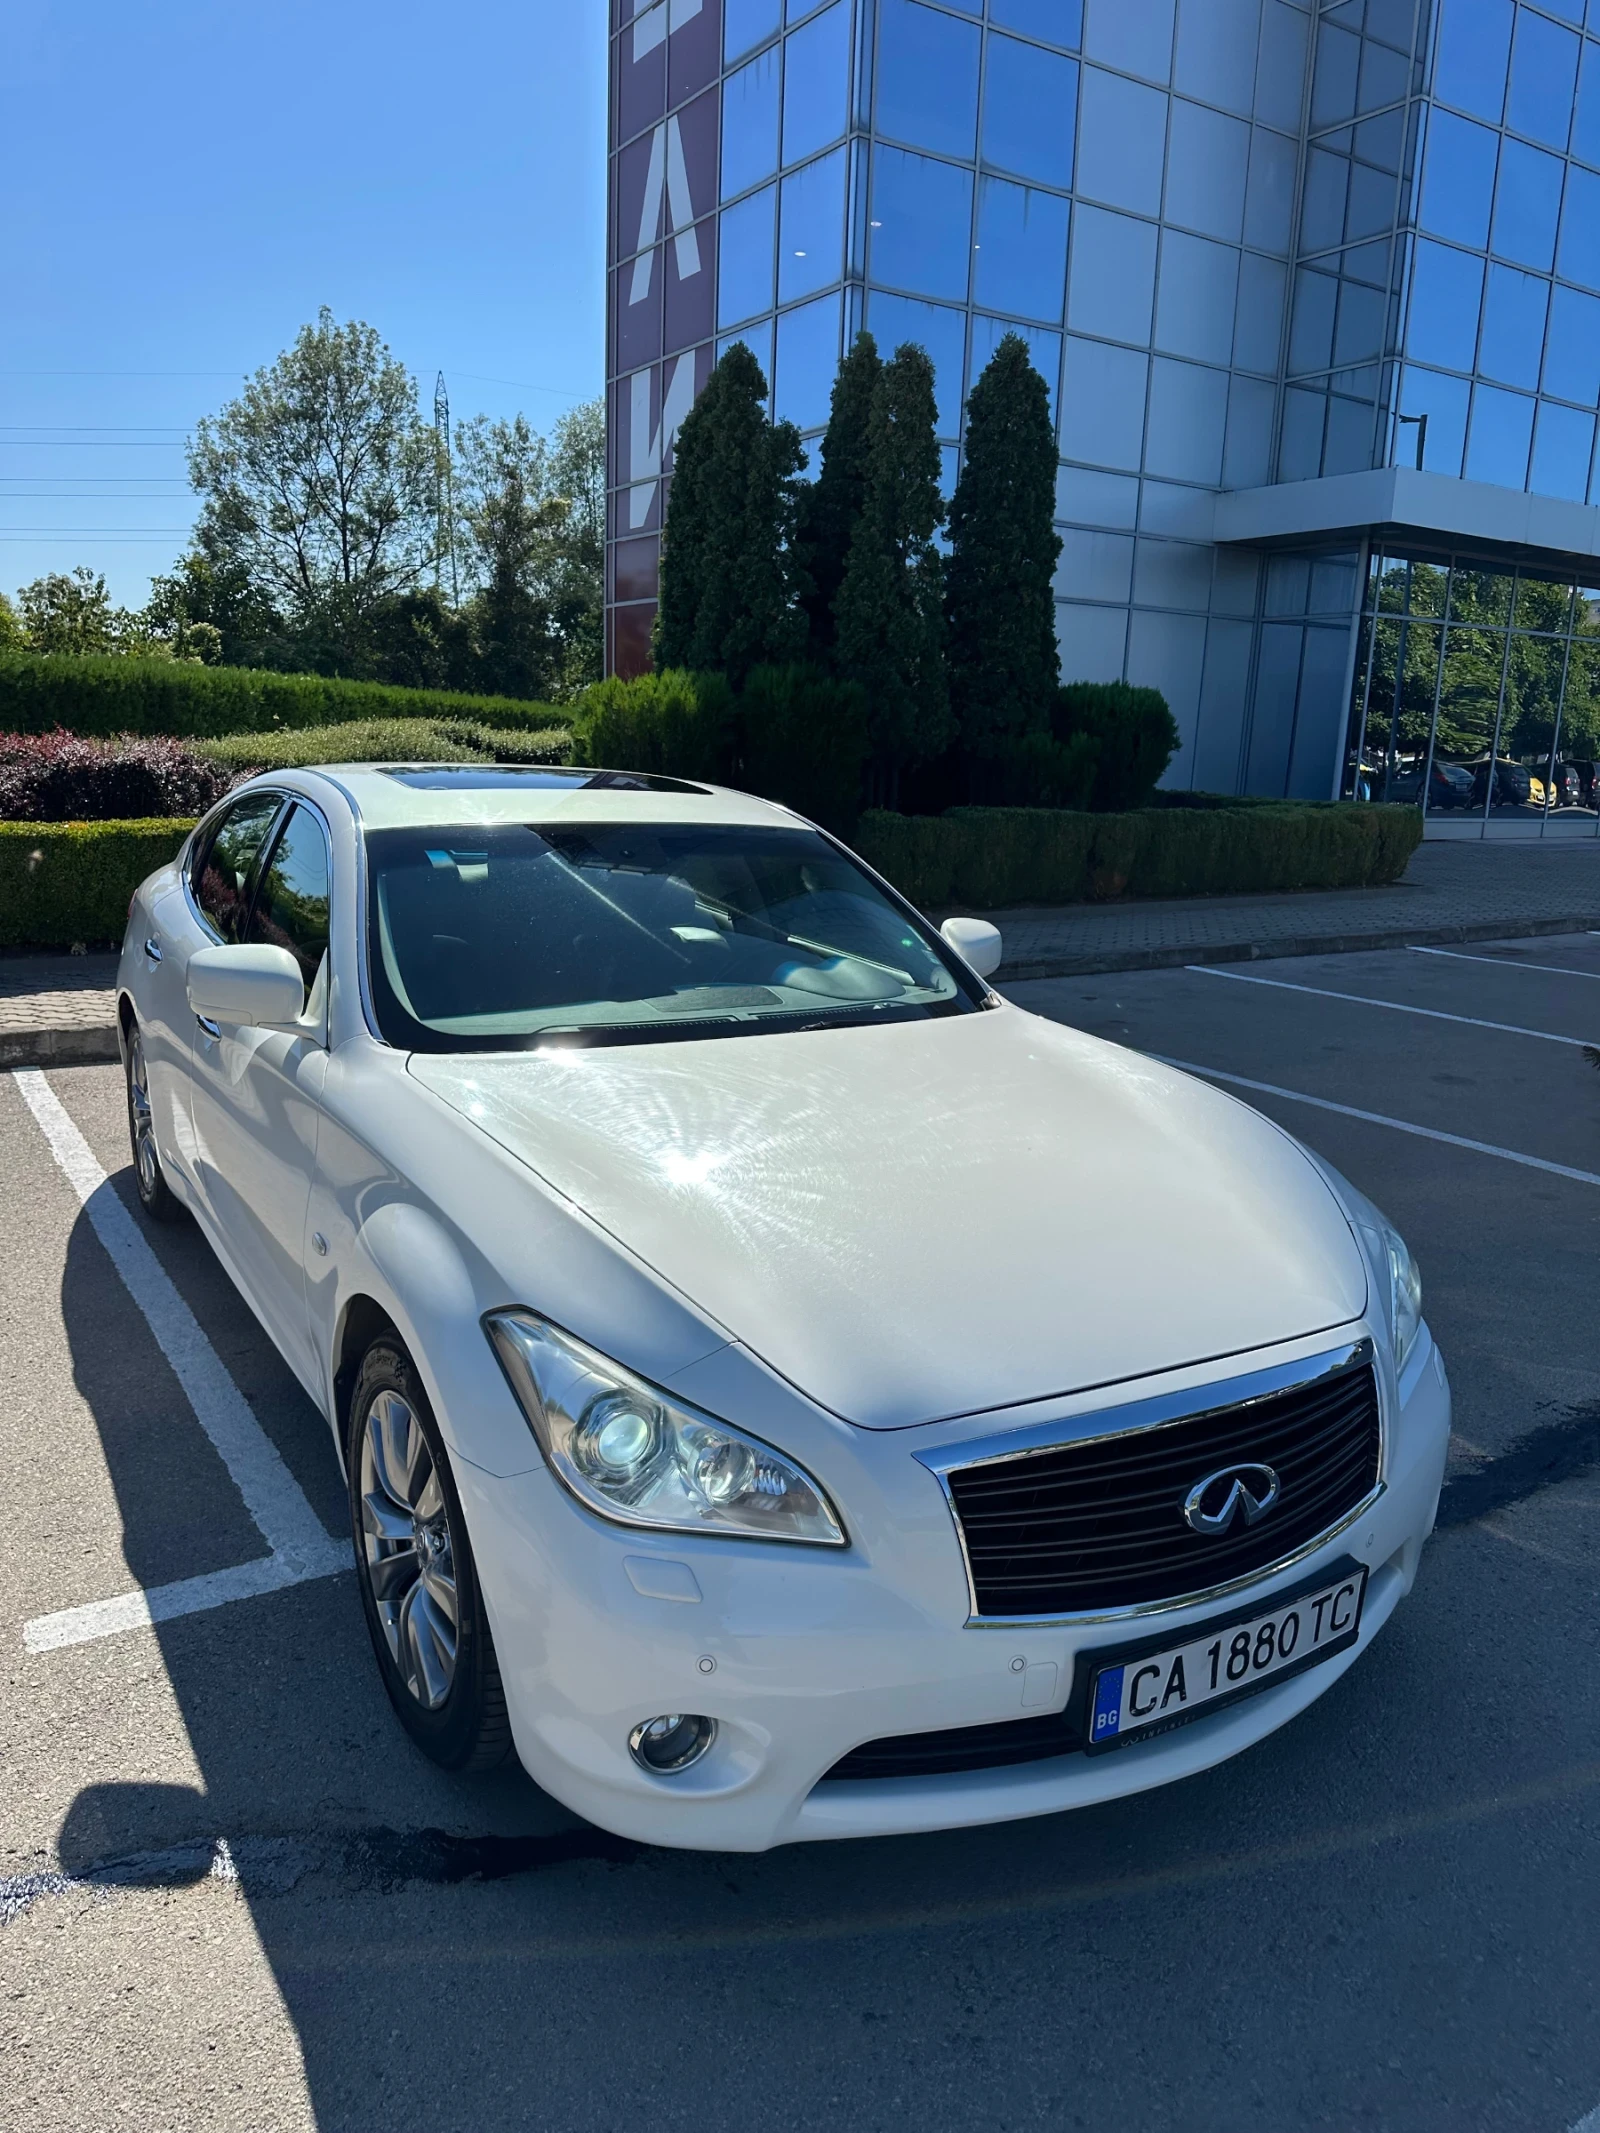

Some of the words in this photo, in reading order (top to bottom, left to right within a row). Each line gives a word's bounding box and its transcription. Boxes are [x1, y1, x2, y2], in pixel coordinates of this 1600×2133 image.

[1129, 1655, 1187, 1717] CA
[1208, 1612, 1300, 1690] 1880
[1311, 1584, 1354, 1643] TC
[1097, 1709, 1118, 1729] BG
